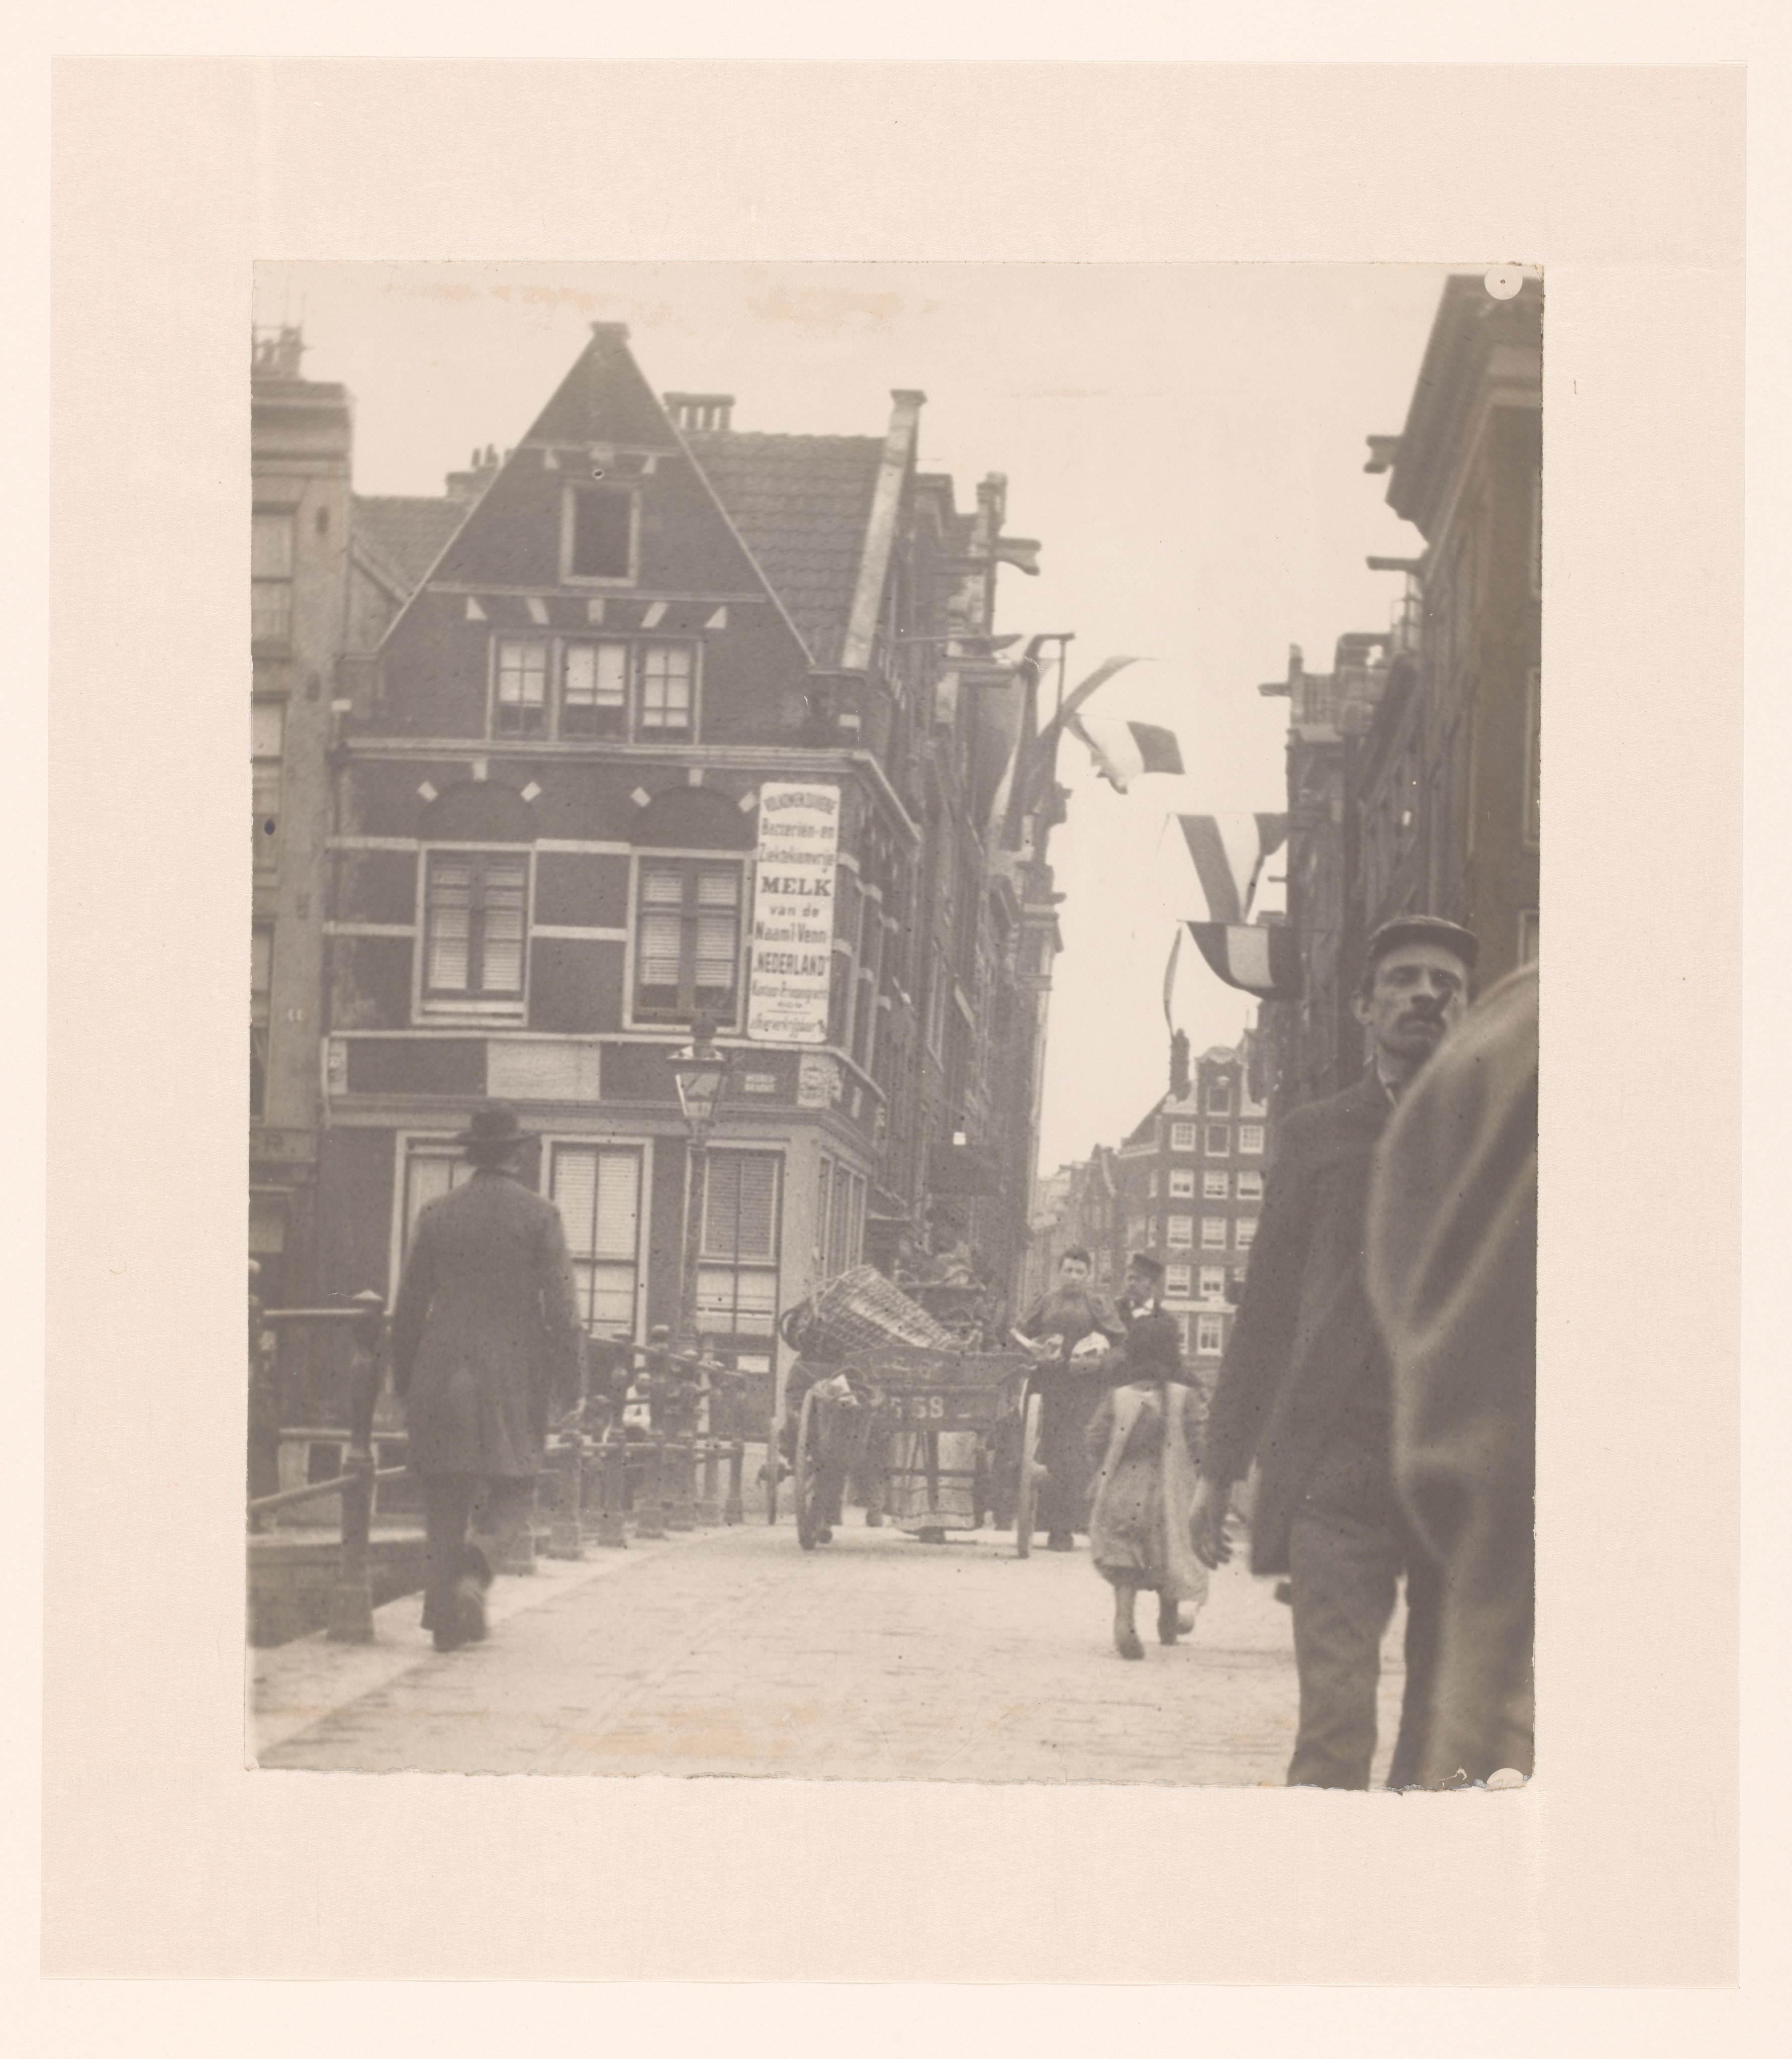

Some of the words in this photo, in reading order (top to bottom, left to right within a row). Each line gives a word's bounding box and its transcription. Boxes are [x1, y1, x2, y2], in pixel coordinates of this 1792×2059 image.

[761, 876, 832, 897] MELK
[769, 906, 796, 916] van
[802, 903, 820, 918] de
